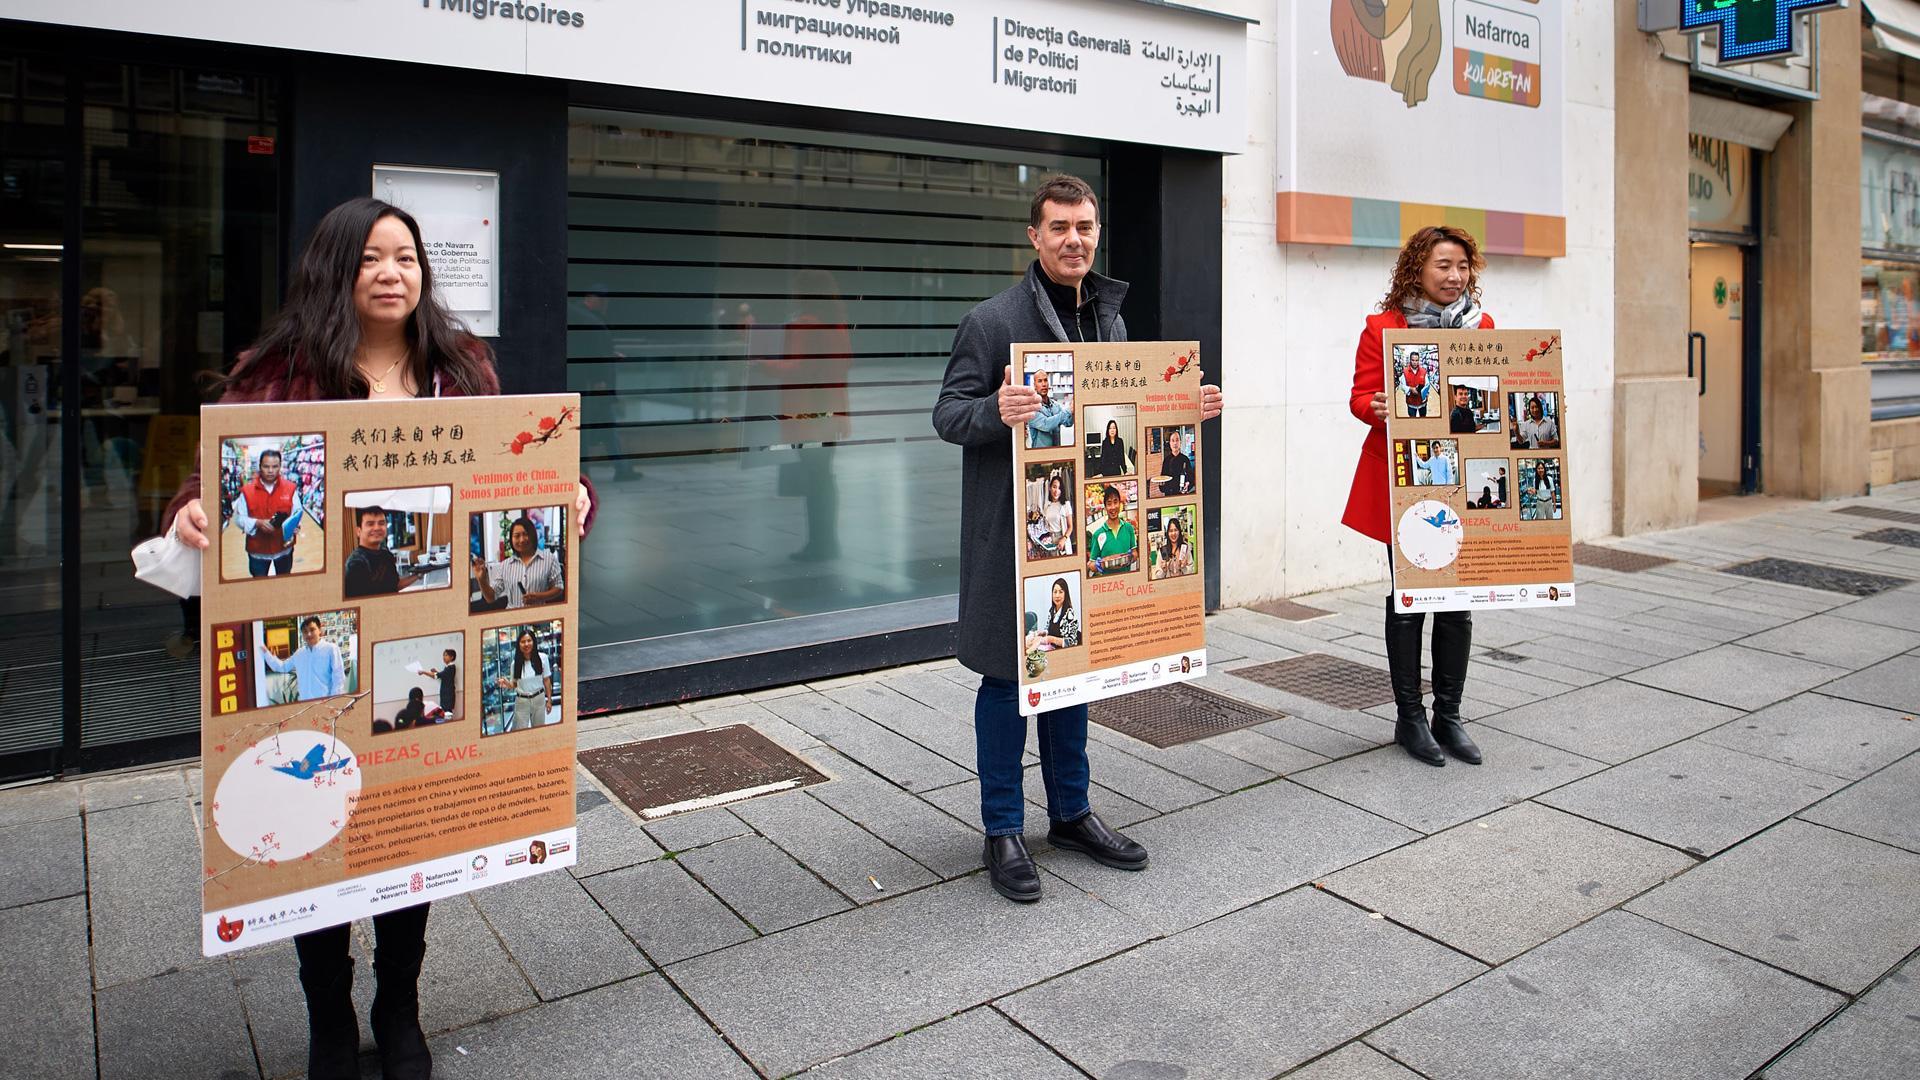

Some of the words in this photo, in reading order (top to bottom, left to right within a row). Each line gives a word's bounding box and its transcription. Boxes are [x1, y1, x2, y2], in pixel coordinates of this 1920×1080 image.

[441, 0, 584, 27] Migratoires
[847, 0, 954, 26] управление
[757, 10, 900, 44] миграционной
[1466, 14, 1529, 49] Nafarroa
[757, 38, 852, 64] политики
[1068, 30, 1131, 55] Generală
[1004, 45, 1023, 62] de
[1028, 48, 1079, 71] Politici
[1004, 69, 1077, 94] Migratorii
[1463, 62, 1531, 93] KOLORETAN
[1176, 97, 1211, 118] الهجرة
[1689, 132, 1731, 196] MACIA
[1689, 172, 1713, 200] UJO
[1084, 360, 1141, 372] 我们来自中国
[351, 425, 464, 445] 我们来自中国
[342, 448, 477, 472] 我们都在纳瓦拉
[472, 472, 513, 486] Venimos
[516, 471, 528, 482] de
[530, 470, 560, 481] China.
[459, 487, 491, 500] Somos
[494, 485, 520, 499] parte
[522, 484, 535, 496] de
[537, 481, 574, 495] Navarra
[1460, 517, 1491, 526] PIEZAS
[1092, 580, 1125, 594] PIEZAS
[1126, 584, 1156, 597] CLAVE.
[216, 629, 238, 714] BACO
[357, 743, 421, 766] PIEZAS
[423, 744, 483, 767] CLAVE.
[348, 805, 381, 816] Quienes
[383, 797, 416, 809] nacimos
[429, 789, 451, 800] China
[459, 783, 488, 793] vivimos
[506, 772, 537, 783] también
[537, 769, 545, 777] lo
[348, 793, 380, 803] Navarra
[393, 784, 417, 794] activa
[348, 820, 376, 830] Somos
[377, 808, 425, 823] propietarios
[433, 798, 477, 812] trabajamos
[431, 813, 459, 824] tiendas
[460, 810, 471, 818] de
[472, 806, 489, 816] ropa
[497, 802, 507, 810] de
[438, 825, 466, 836] centros
[468, 821, 477, 829] de
[425, 868, 463, 881] Nafarroako
[425, 877, 459, 889] Gobernua
[370, 895, 379, 903] de
[380, 889, 408, 900] Navarra
[375, 881, 408, 894] Gobierno
